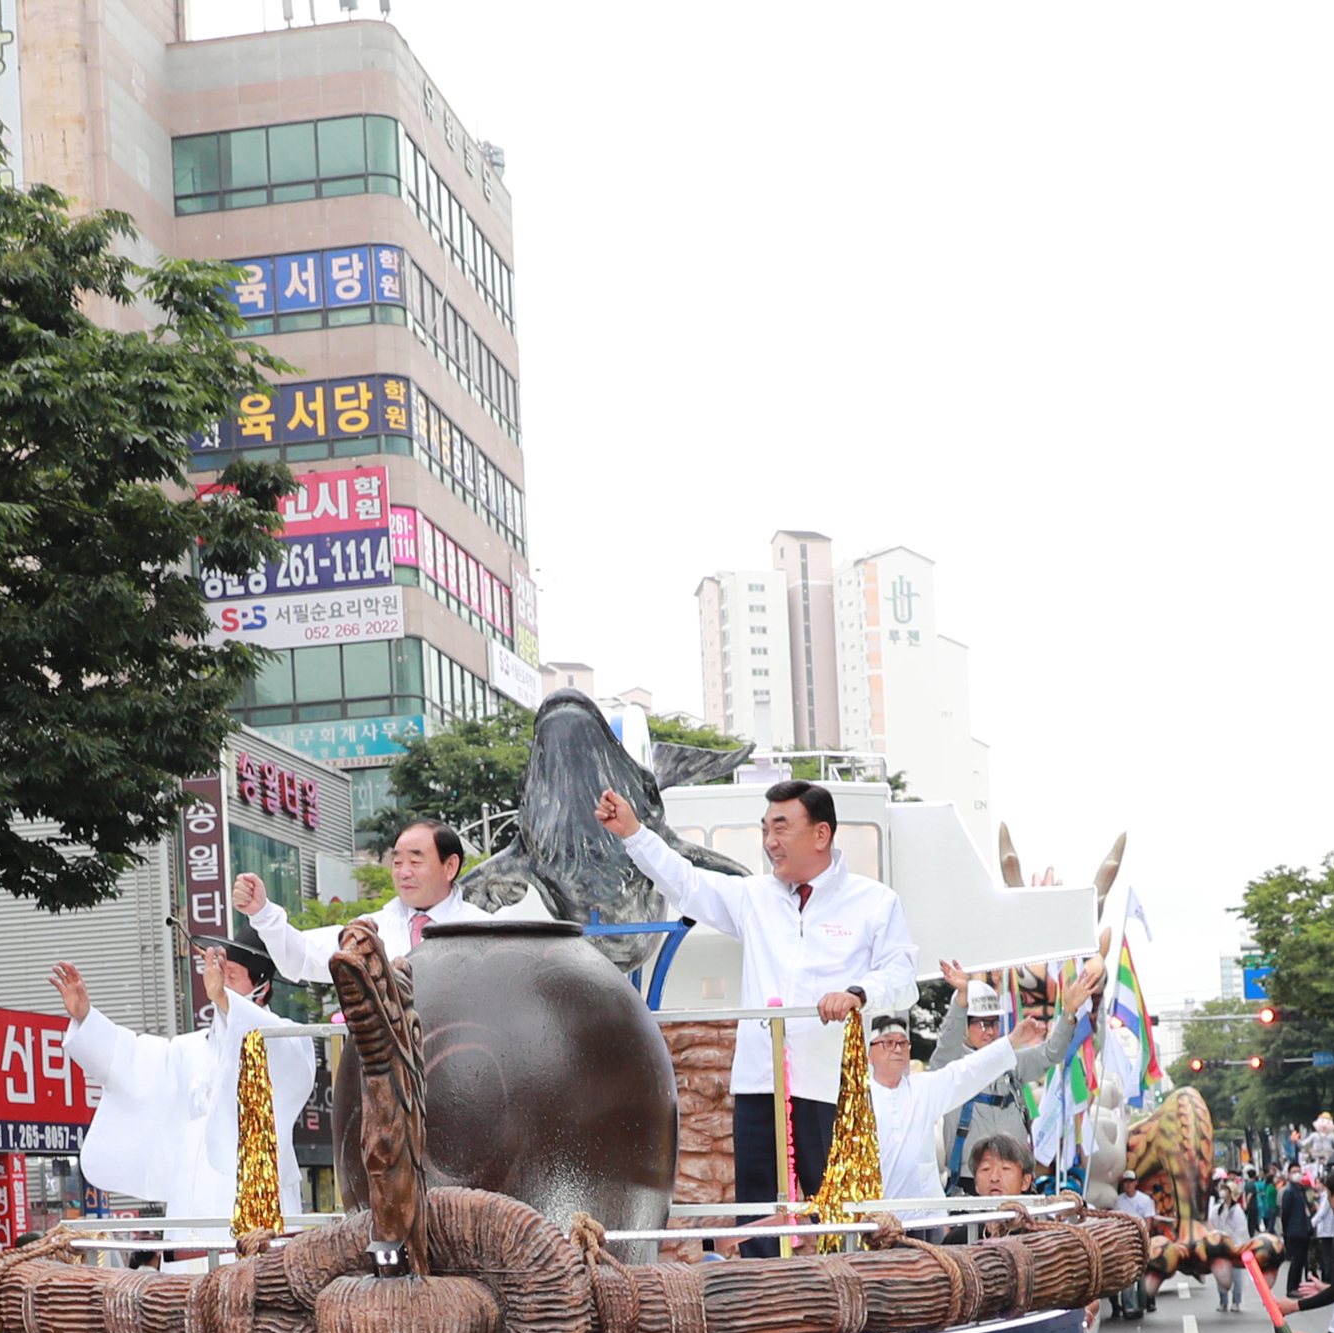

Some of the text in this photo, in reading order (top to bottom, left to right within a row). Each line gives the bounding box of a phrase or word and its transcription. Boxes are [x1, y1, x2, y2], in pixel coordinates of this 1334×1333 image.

[234, 250, 402, 309] 육서당 학원
[237, 381, 375, 442] 육서당
[384, 379, 409, 431] 학원
[353, 476, 383, 521] 학원
[276, 536, 392, 588] 261-1114
[275, 594, 398, 626] 서필순요리학원
[304, 619, 399, 641] 052 266 2022
[238, 751, 321, 829] 송월타월
[186, 801, 225, 976] 송월타
